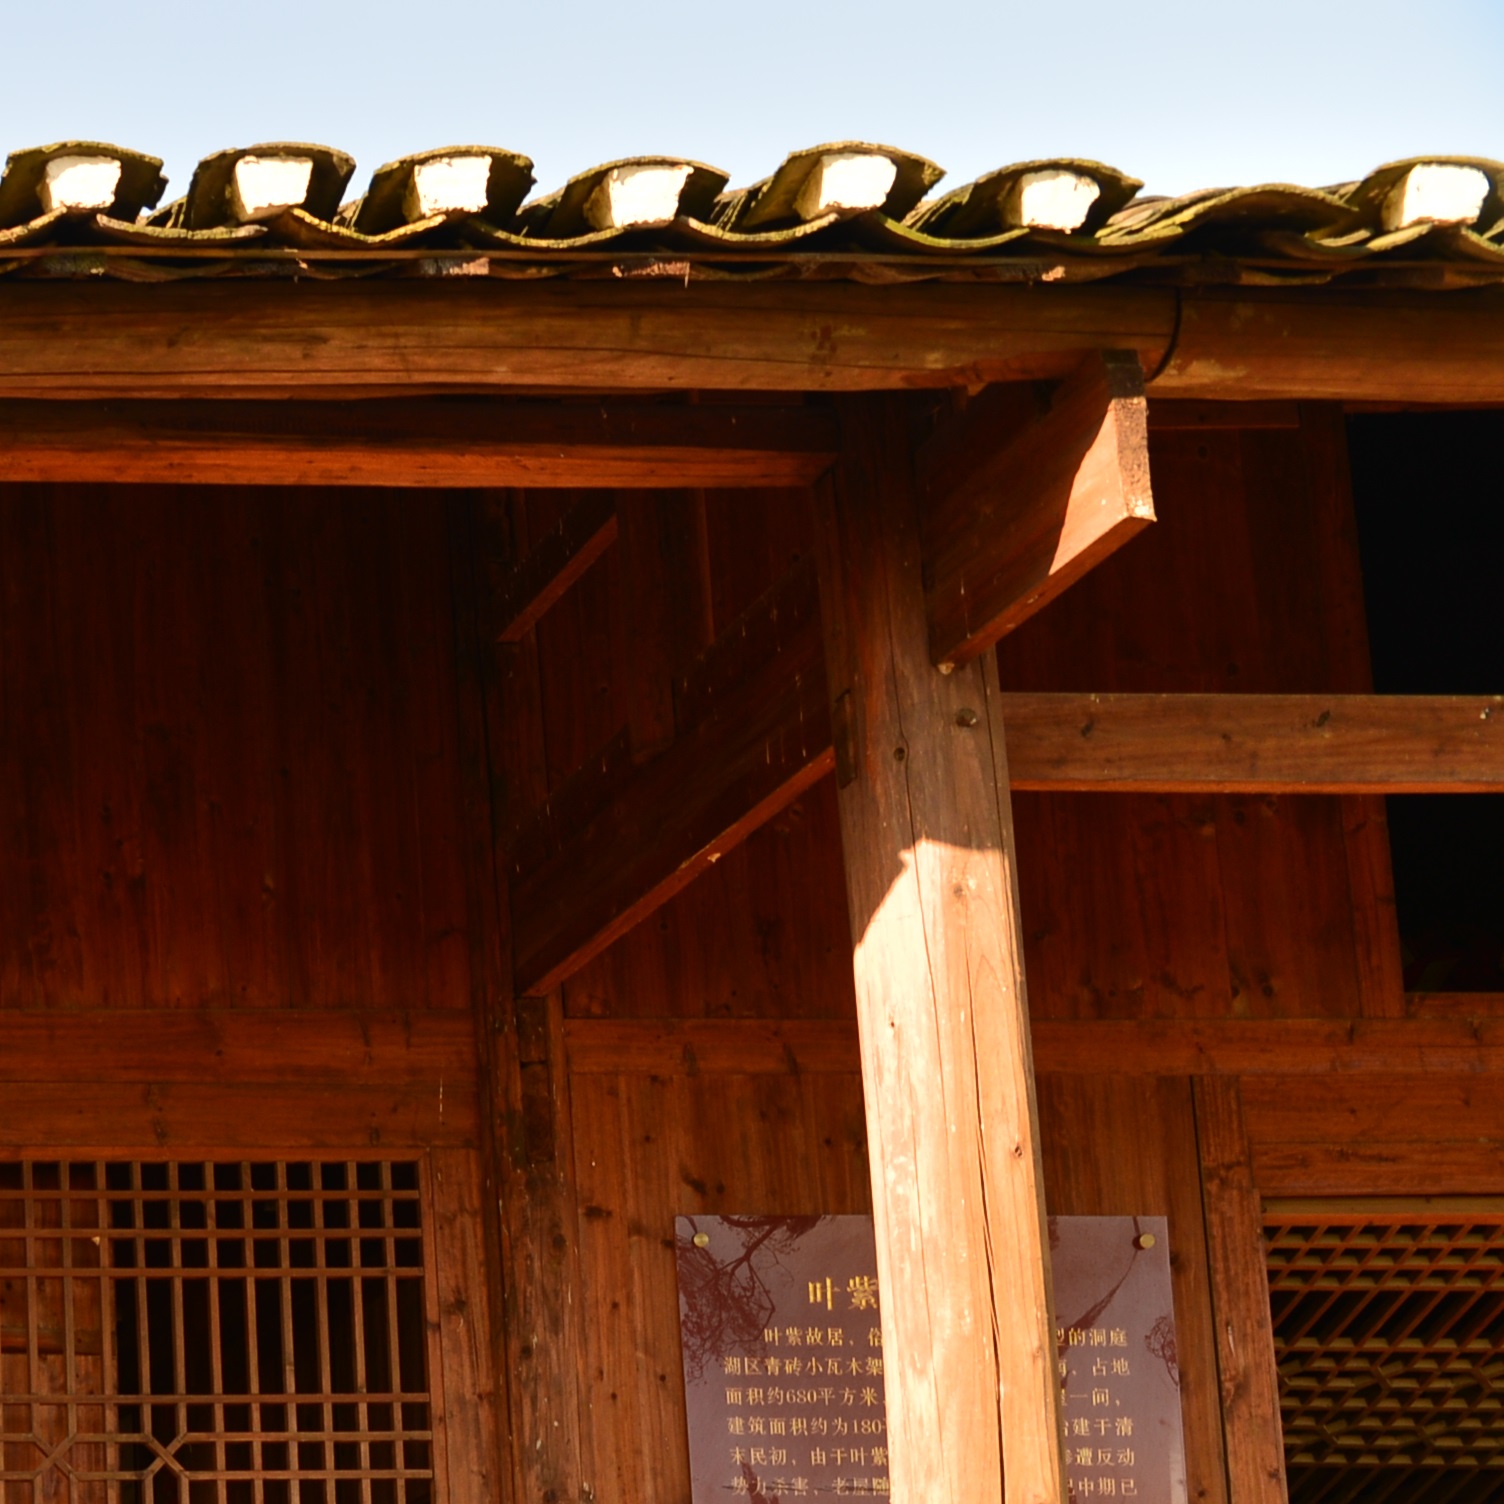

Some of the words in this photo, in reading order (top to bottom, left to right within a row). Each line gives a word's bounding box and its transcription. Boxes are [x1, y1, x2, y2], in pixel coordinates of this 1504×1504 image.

[808, 1275, 878, 1311] 叶紫
[724, 1356, 883, 1377] 湖区青砖小瓦木架
[726, 1387, 886, 1407] 面积约680平方米
[728, 1417, 887, 1437] 建筑面积约为180
